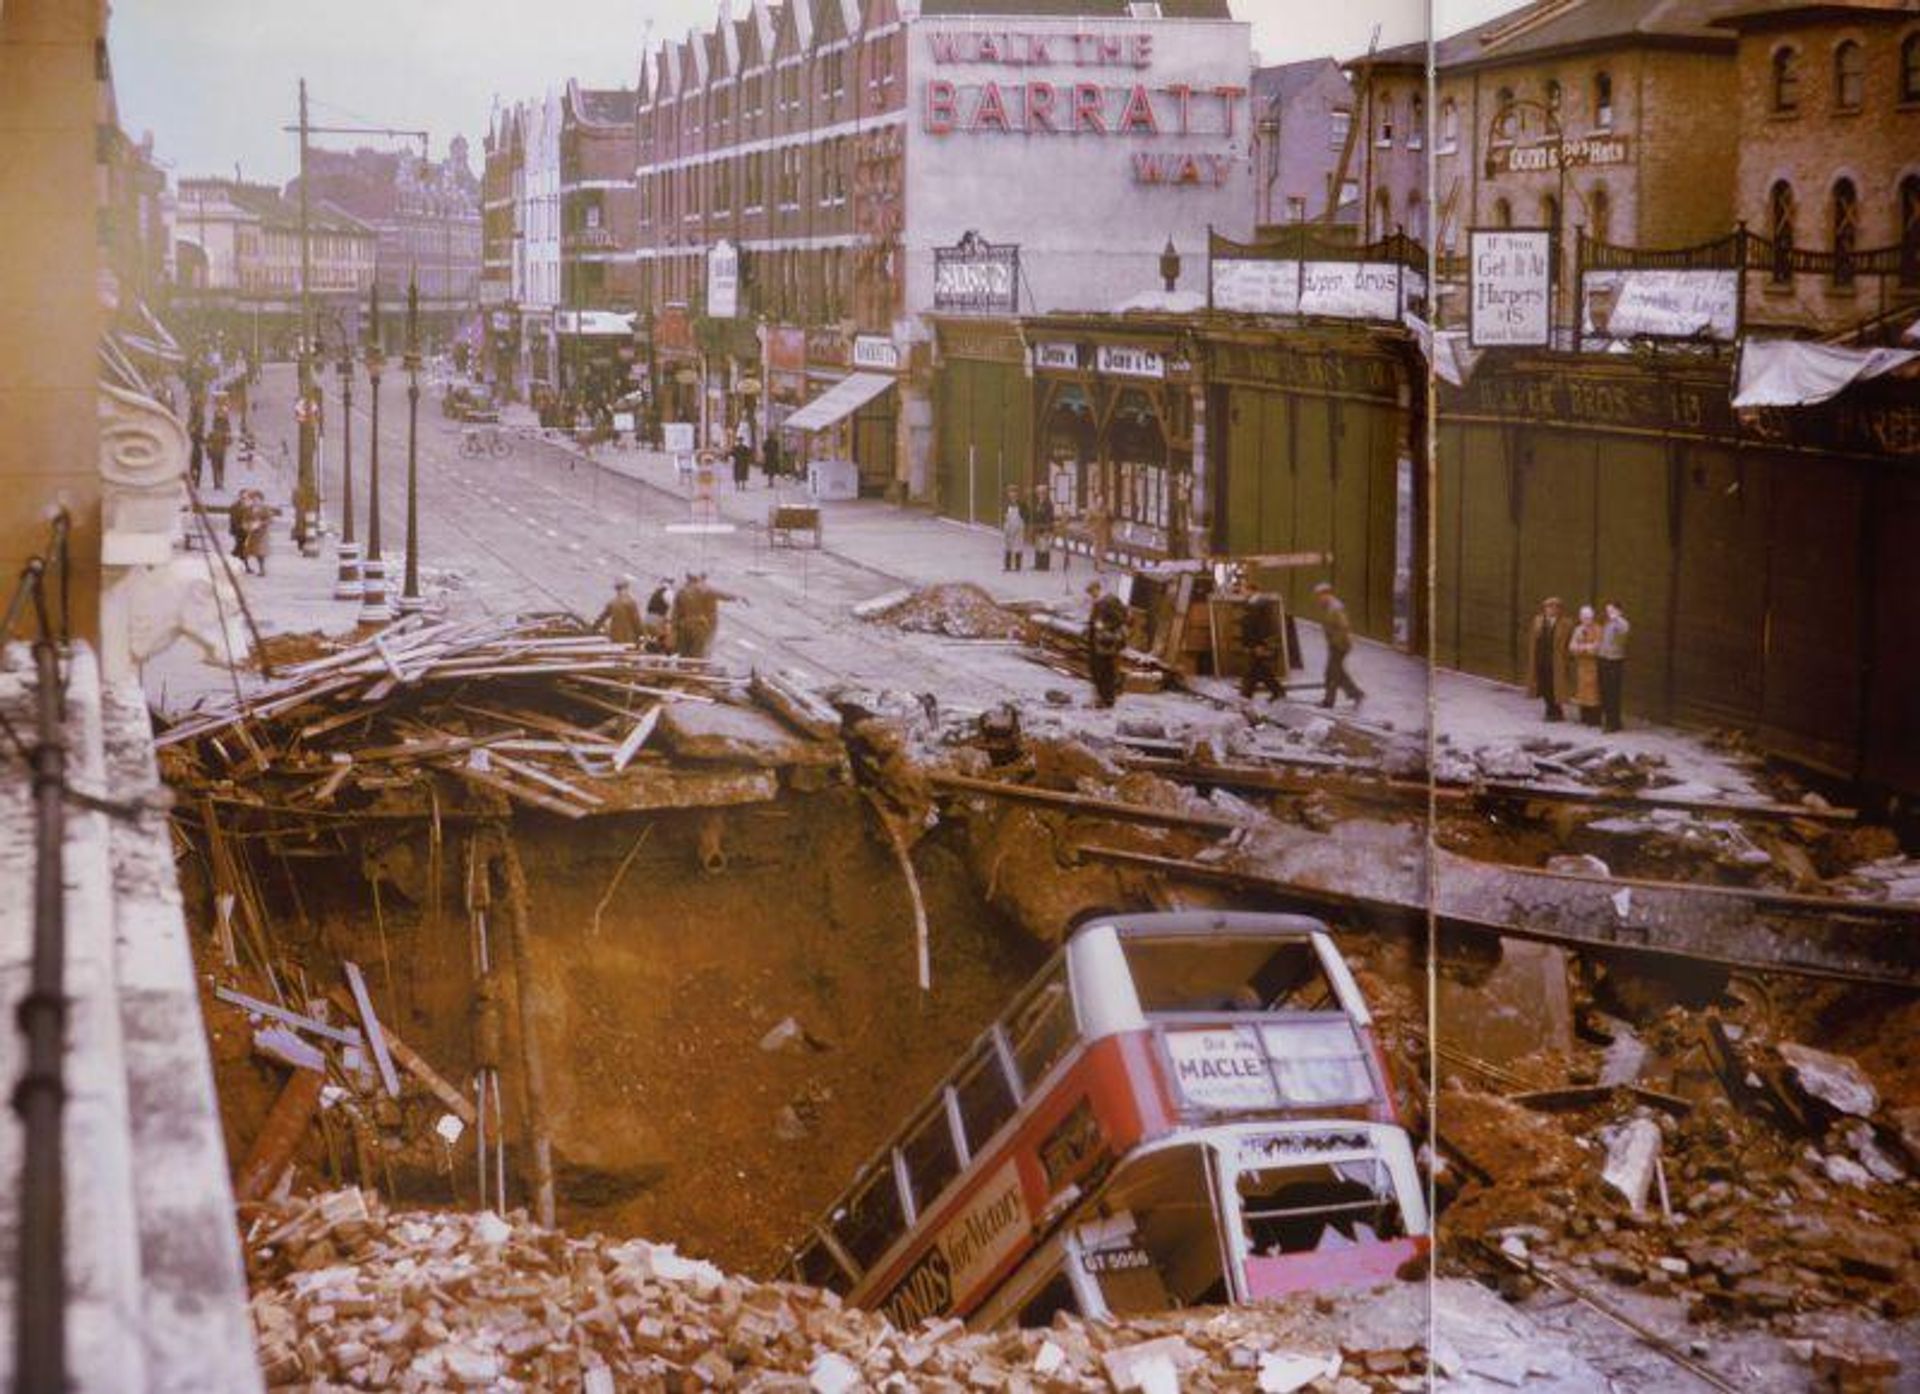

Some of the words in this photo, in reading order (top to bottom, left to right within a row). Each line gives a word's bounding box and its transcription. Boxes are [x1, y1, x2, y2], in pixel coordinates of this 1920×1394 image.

[927, 32, 1049, 66] WALK
[1074, 34, 1152, 69] THE
[925, 81, 1247, 136] BARRATT
[1131, 153, 1231, 187] WAY
[1478, 252, 1506, 278] Get
